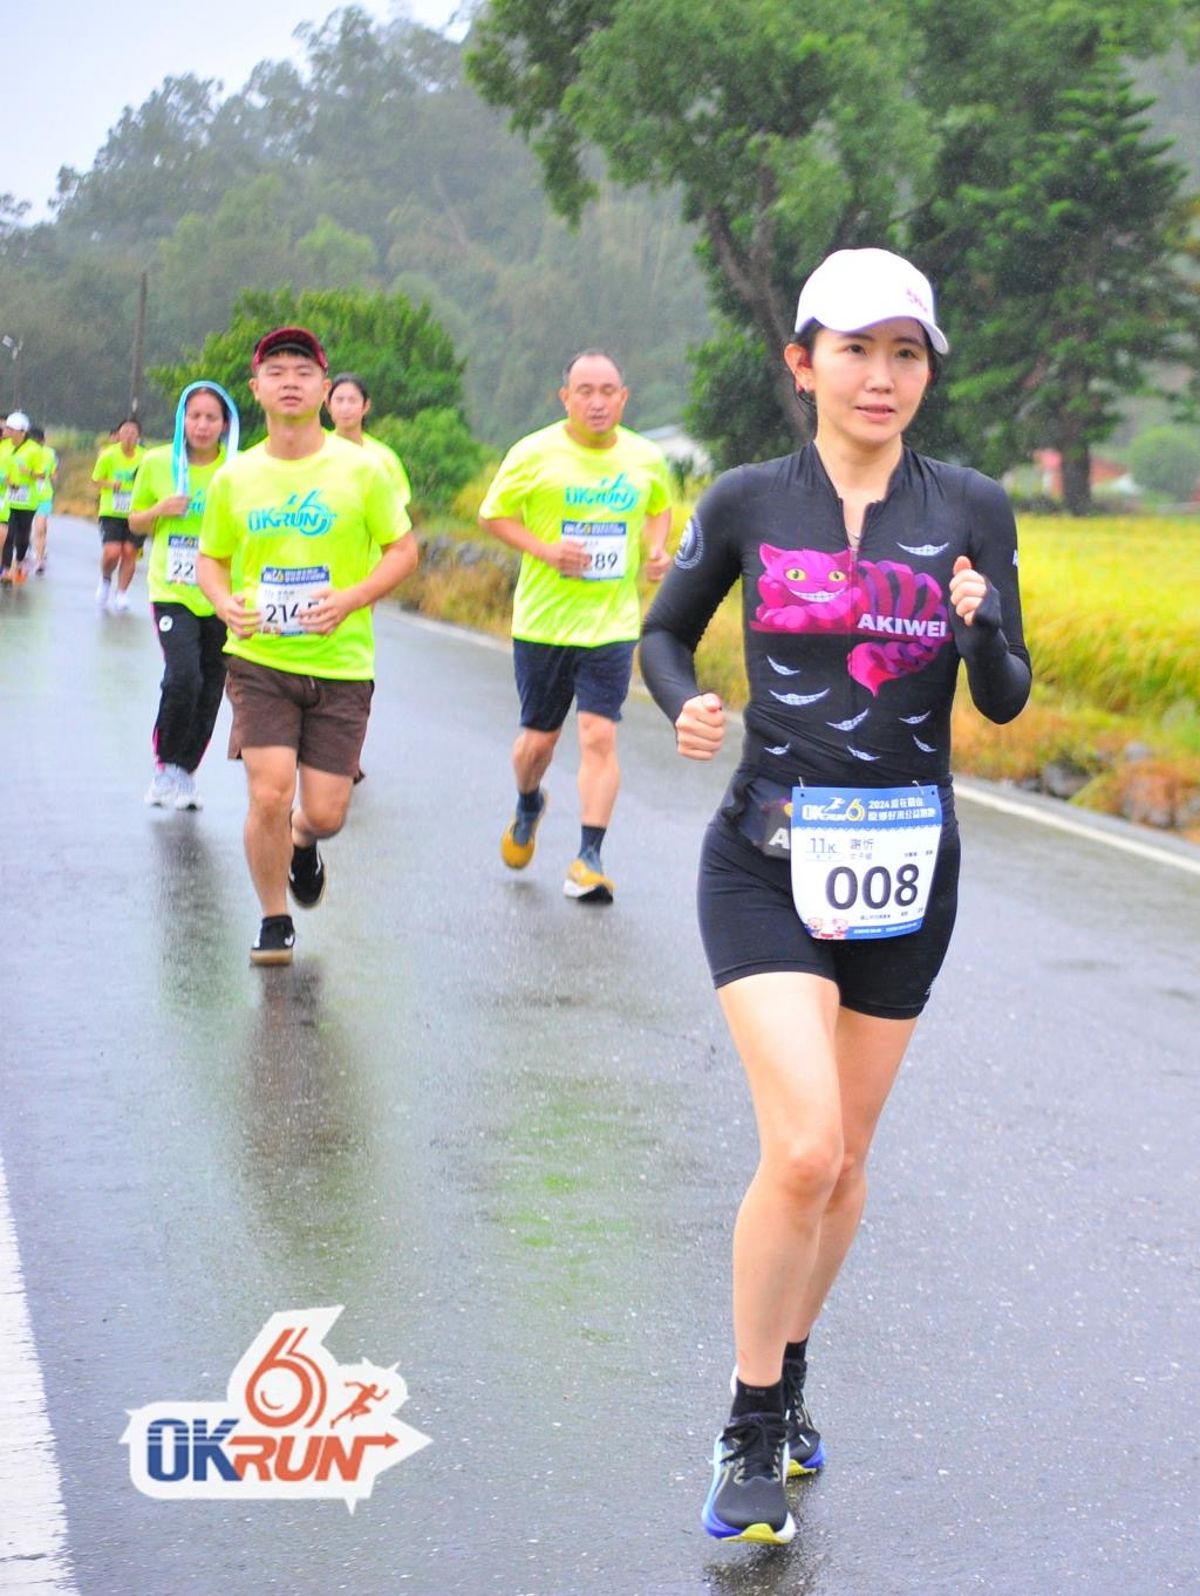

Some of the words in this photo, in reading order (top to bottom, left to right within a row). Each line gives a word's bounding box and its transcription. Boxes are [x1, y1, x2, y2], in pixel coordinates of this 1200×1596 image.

[248, 509, 320, 532] OKRUN
[857, 613, 947, 637] AKIWEI
[825, 863, 920, 911] 008
